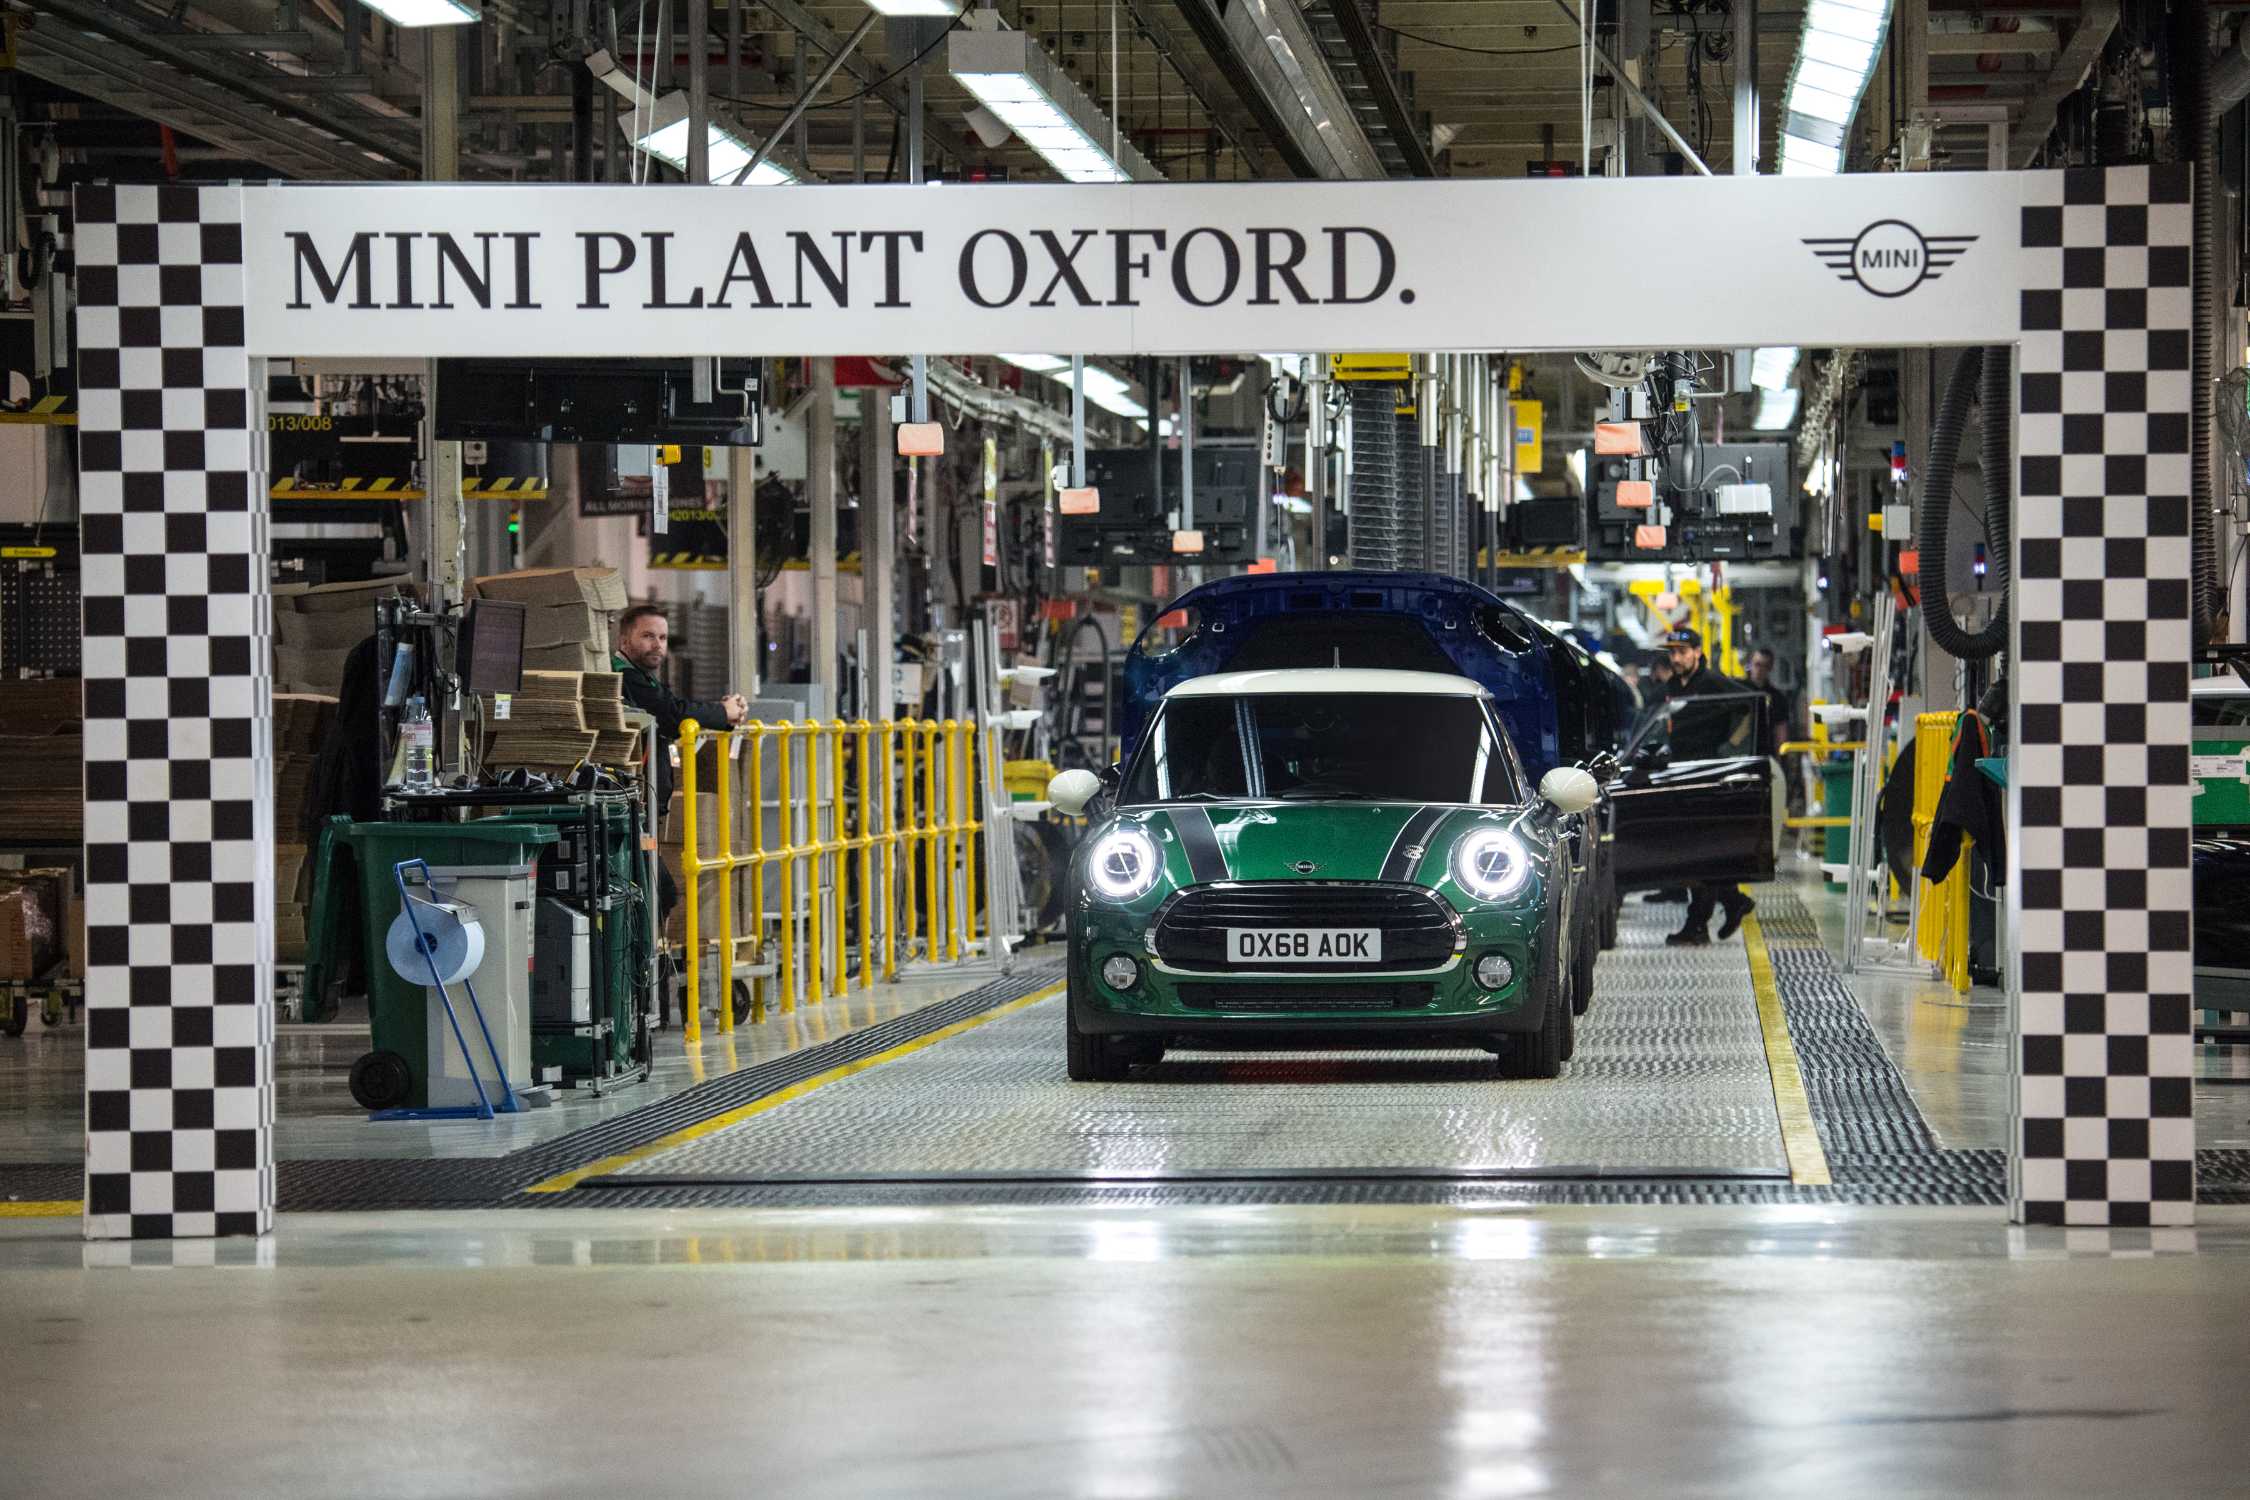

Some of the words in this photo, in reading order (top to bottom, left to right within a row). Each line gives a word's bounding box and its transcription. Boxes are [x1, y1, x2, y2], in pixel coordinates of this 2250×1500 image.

[284, 231, 542, 310] MINI
[575, 231, 924, 310] PLANT
[958, 227, 1416, 309] OXFORD.
[1861, 249, 1920, 268] MINI
[1239, 932, 1309, 958] OX68
[1318, 932, 1369, 958] AOK
